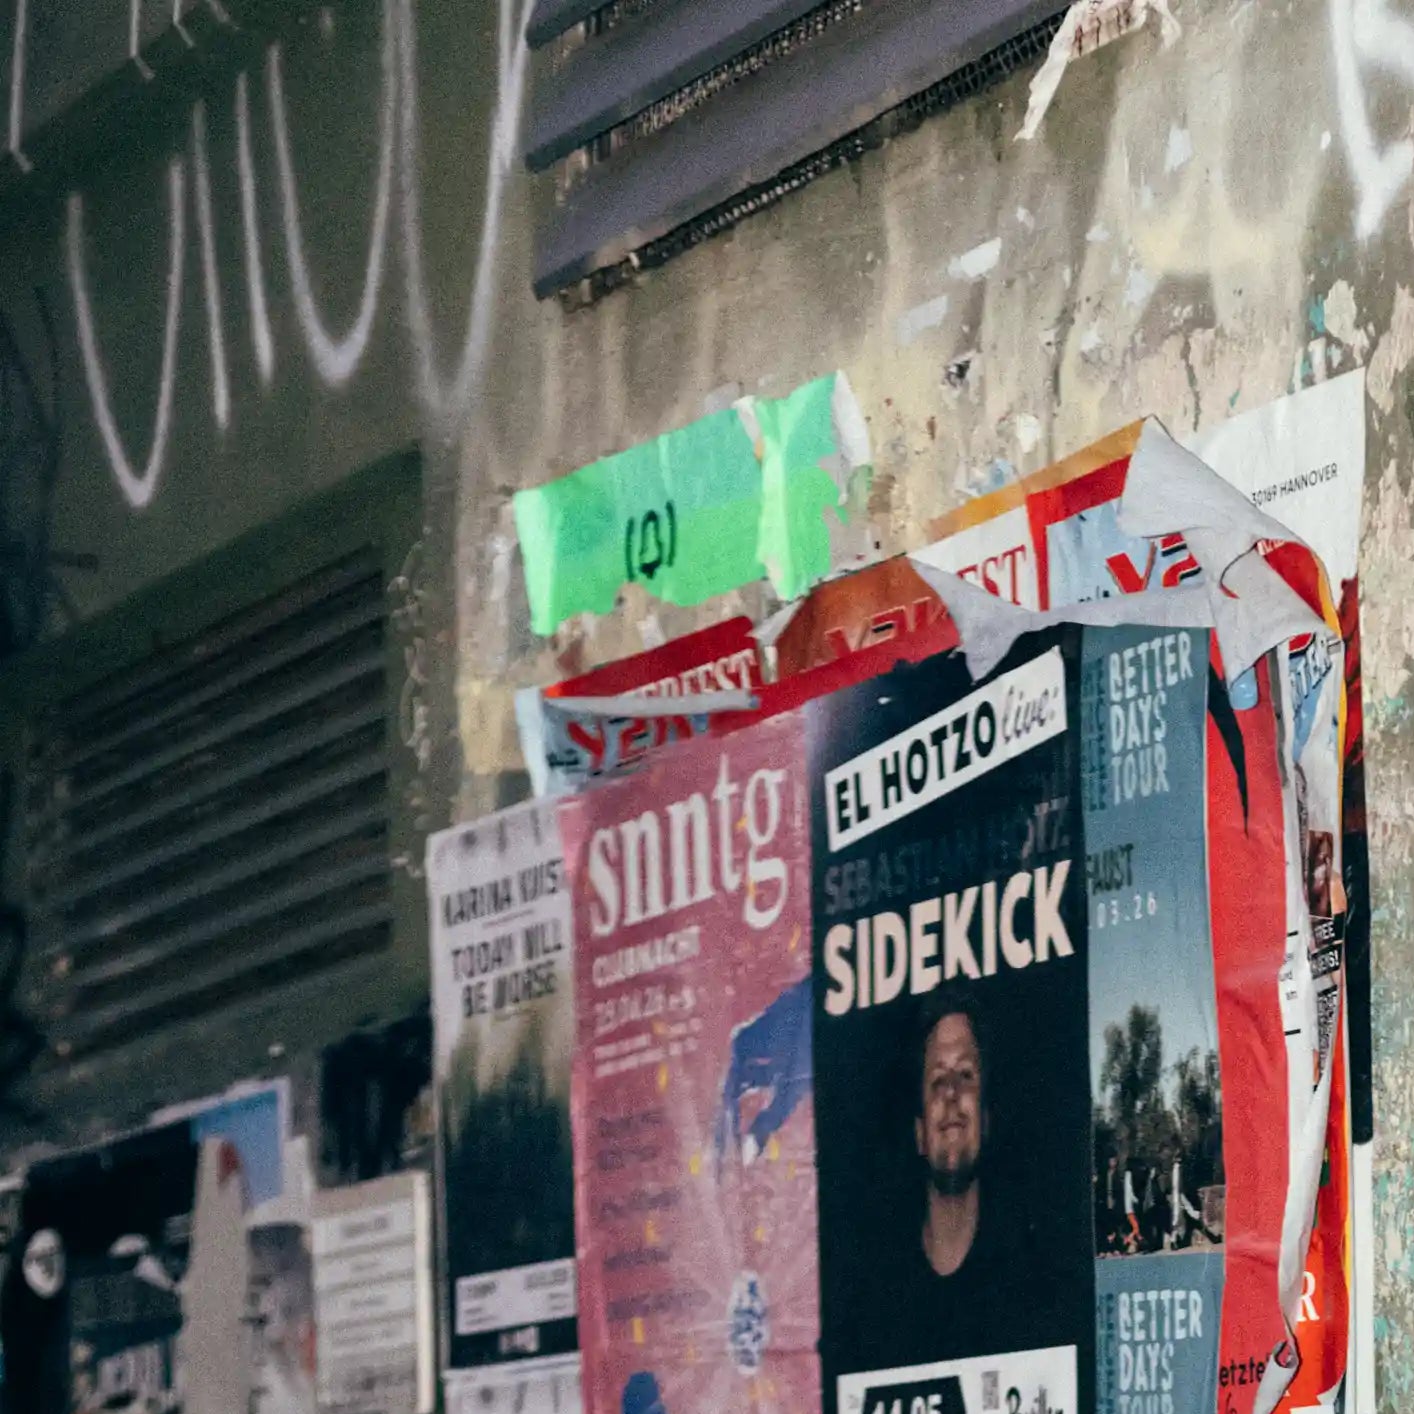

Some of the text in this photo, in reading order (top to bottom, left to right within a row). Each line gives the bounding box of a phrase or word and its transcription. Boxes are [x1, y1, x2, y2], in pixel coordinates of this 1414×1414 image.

[1279, 462, 1339, 498] HANNOVER
[1108, 631, 1194, 702] BETTER
[1110, 690, 1167, 754] DAYS
[832, 774, 872, 835] EL
[878, 700, 997, 810] HOTZO
[1111, 747, 1171, 804] TOUR
[588, 752, 788, 930] snntg
[823, 859, 1075, 1016] SIDEKICK
[1118, 1290, 1203, 1341] BETTER
[1118, 1342, 1174, 1393] DAYS
